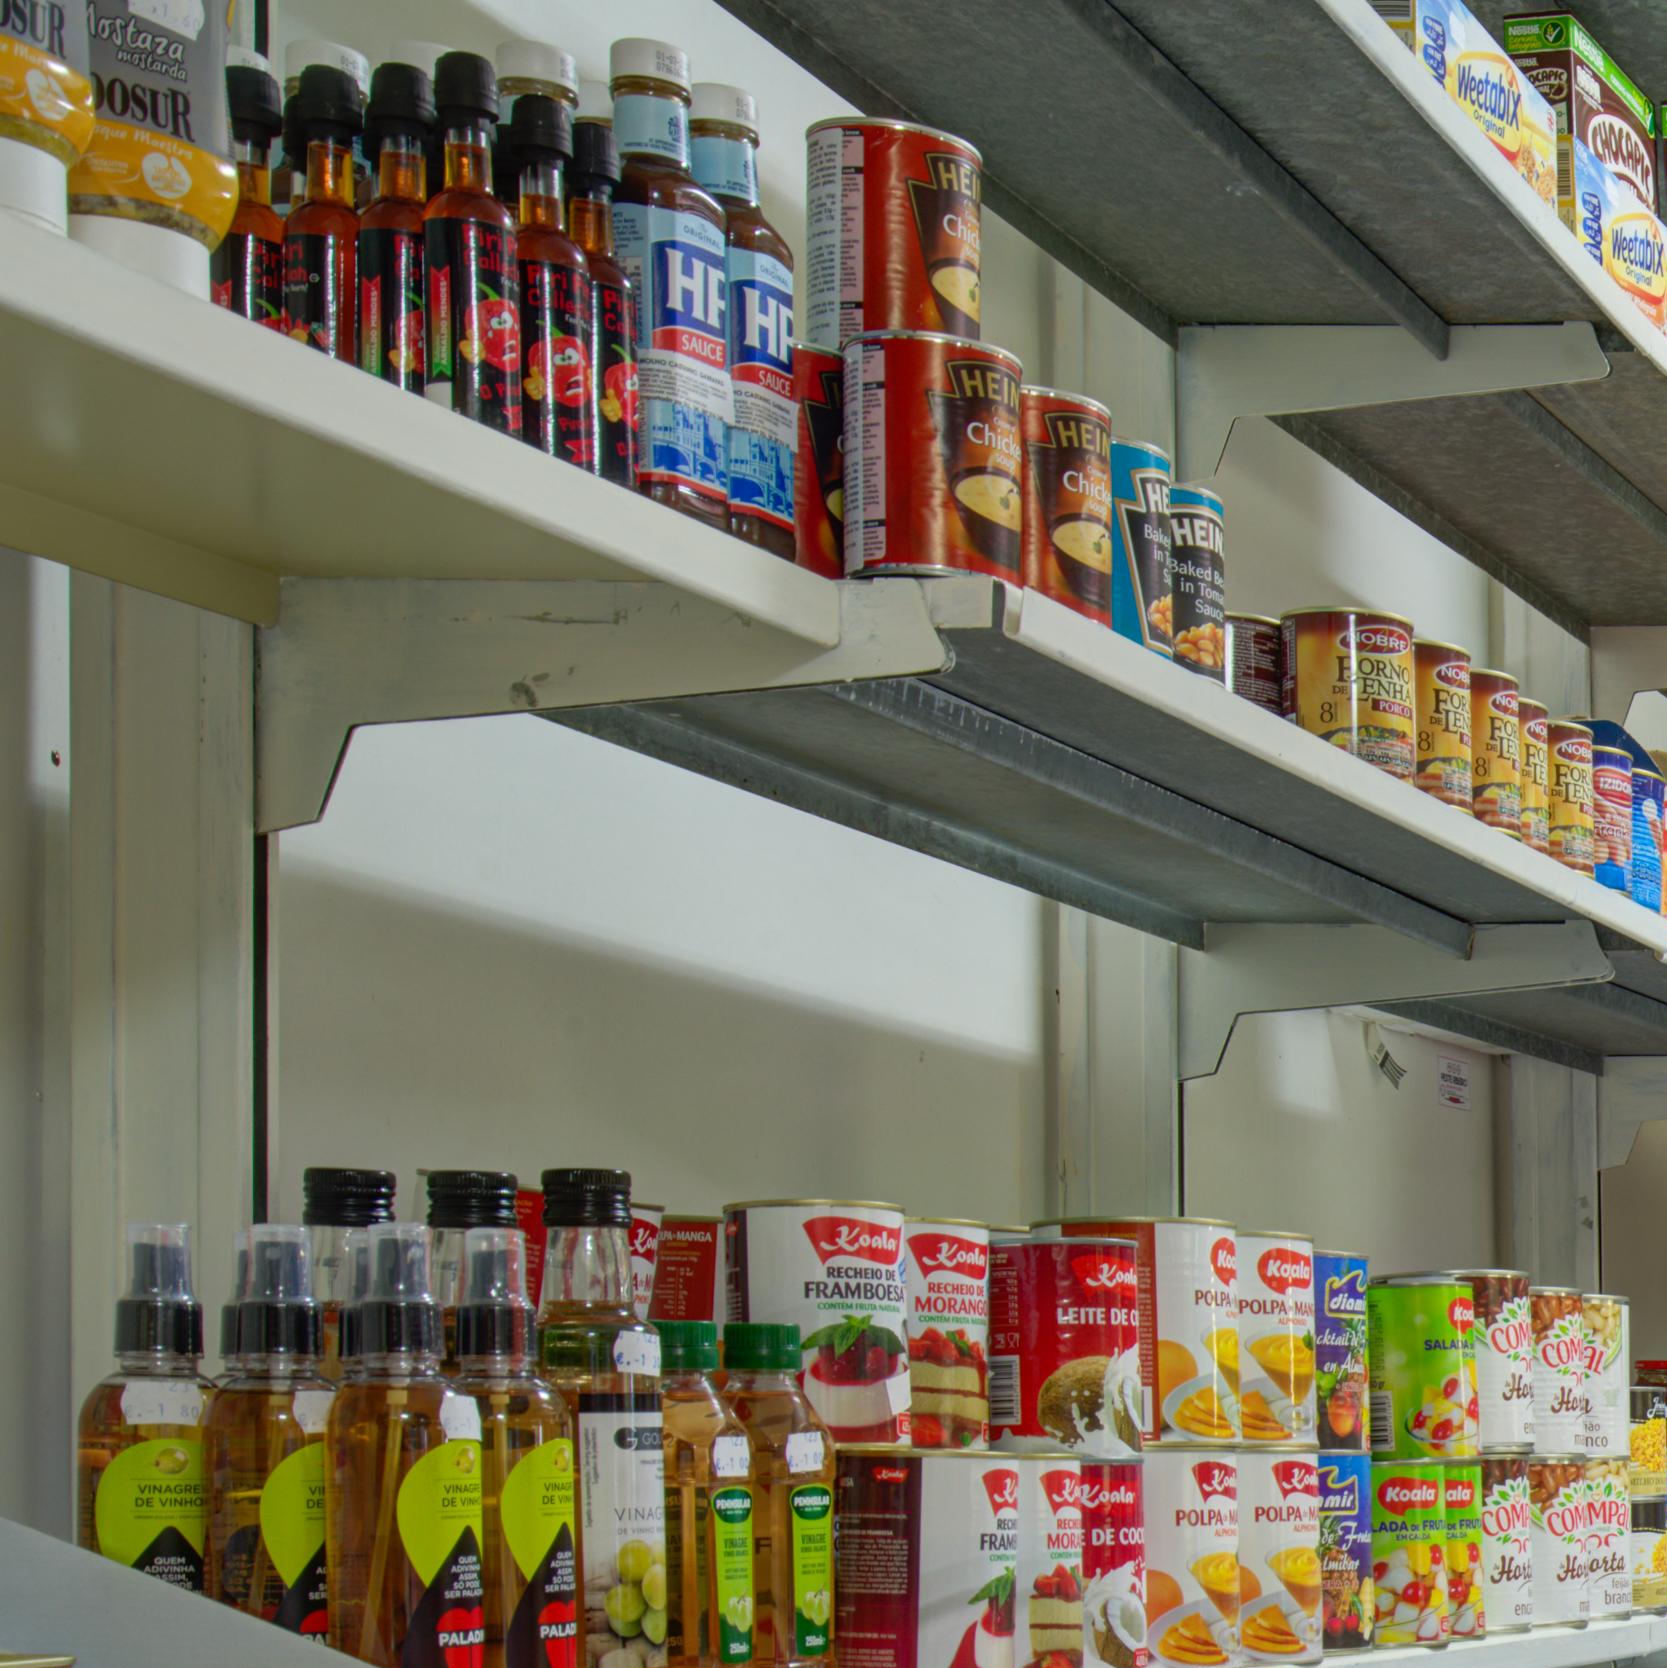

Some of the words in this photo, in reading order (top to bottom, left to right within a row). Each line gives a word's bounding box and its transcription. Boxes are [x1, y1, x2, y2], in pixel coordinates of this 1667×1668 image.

[117, 51, 187, 82] mostarda
[1457, 63, 1521, 131] Weetabix
[1472, 109, 1505, 139] Original
[683, 224, 721, 249] ORIGINAL
[1612, 227, 1664, 277] Weetabix
[743, 286, 793, 366] HP
[681, 334, 723, 363] SAUCE
[759, 370, 791, 398] SAUCE
[1170, 557, 1211, 581] Baked
[1180, 578, 1195, 593] in
[1194, 598, 1224, 622] Sauce
[1345, 629, 1408, 652] NOBRE
[1336, 655, 1410, 685] FORNO
[1378, 700, 1411, 717] PORCO
[1418, 731, 1430, 752] 8
[822, 1227, 898, 1254] Koala
[925, 1240, 986, 1268] Koala
[826, 1266, 880, 1281] RECHEIO
[885, 1270, 896, 1282] DE
[804, 1281, 905, 1303] FRAMBOESA
[927, 1281, 970, 1297] RECHEIO
[973, 1285, 985, 1297] DE
[817, 1301, 849, 1312] CONTÉM
[851, 1302, 873, 1312] FRUTA
[915, 1296, 987, 1316] MORANGO
[1057, 1306, 1106, 1327] LEITE
[1110, 1308, 1128, 1327] DE
[1239, 1299, 1287, 1316] POLPA
[1424, 1338, 1471, 1352] SALADA
[137, 1484, 203, 1496] VINAGRE
[1386, 1485, 1436, 1504] Koala
[135, 1496, 154, 1509] DE
[157, 1496, 204, 1509] VINHO
[1176, 1509, 1222, 1528] POLPA
[144, 1565, 196, 1574] ADIVINHA
[154, 1556, 186, 1567] QUEM
